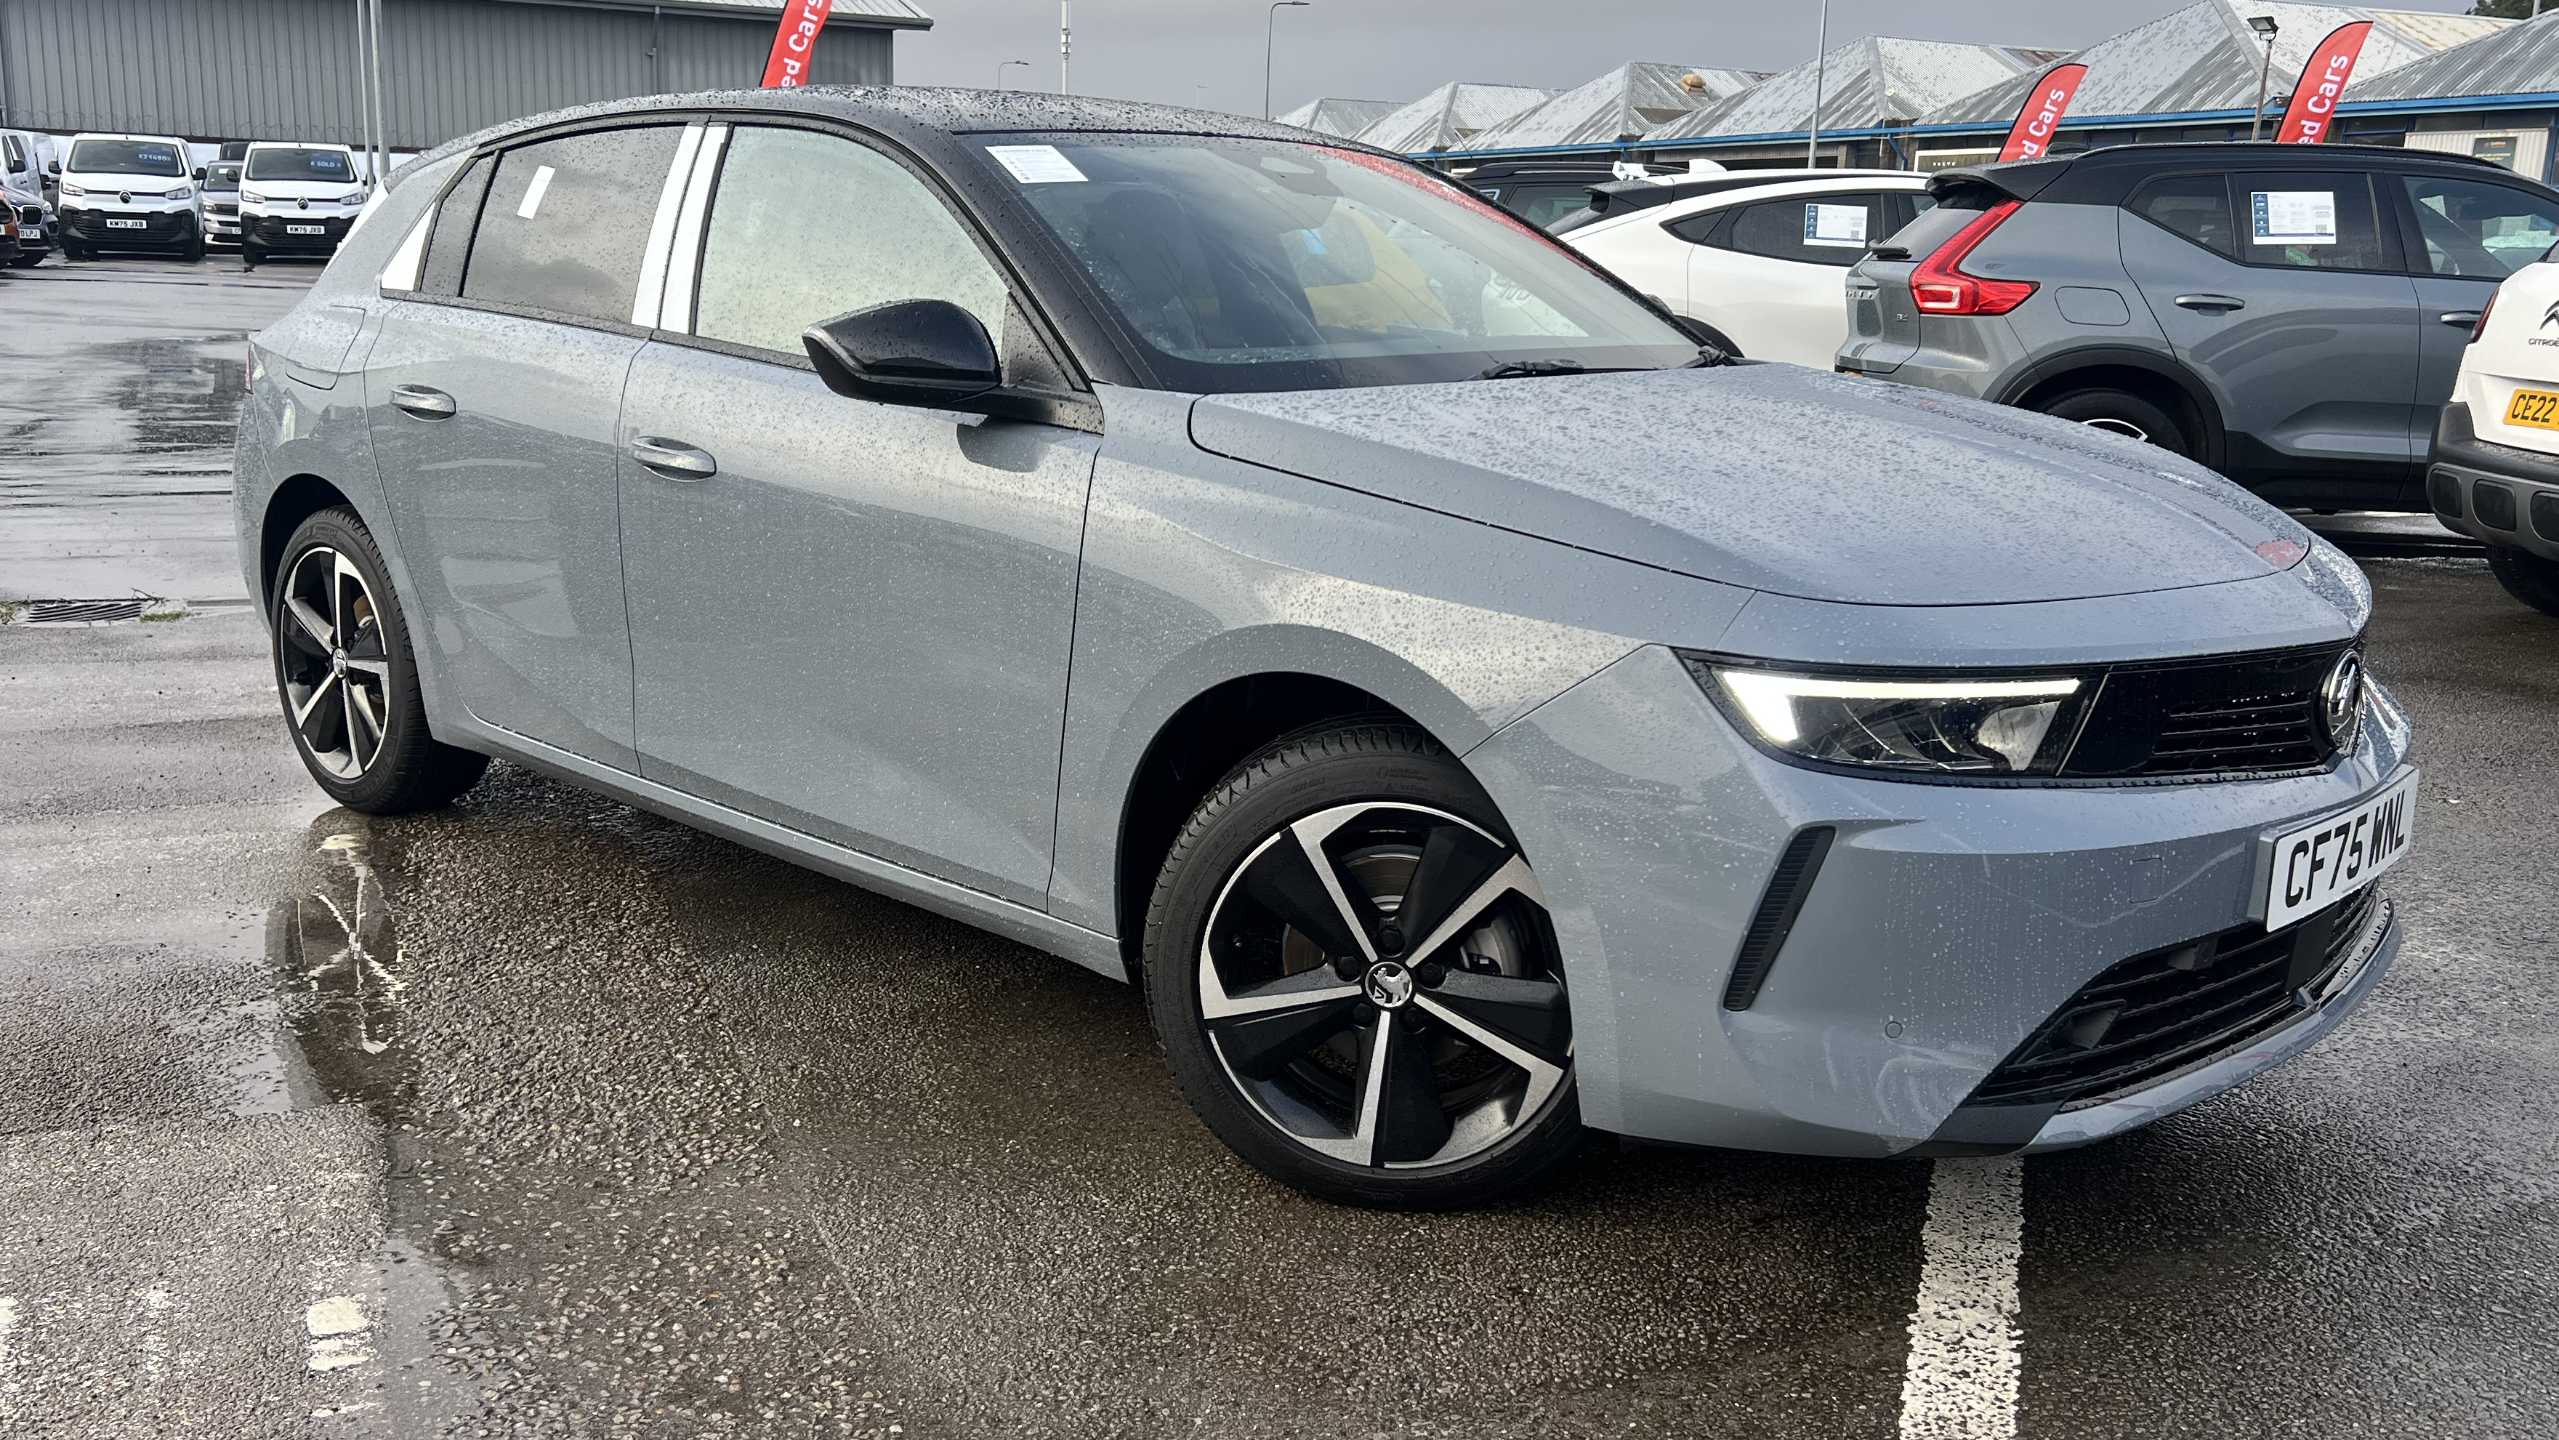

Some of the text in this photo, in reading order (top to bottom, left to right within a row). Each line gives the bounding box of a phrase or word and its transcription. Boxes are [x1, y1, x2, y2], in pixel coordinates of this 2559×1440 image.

[2307, 55, 2348, 114] Cars
[2028, 89, 2065, 137] Cars
[2511, 393, 2558, 423] CE22
[2285, 789, 2406, 909] CF75 WNL
